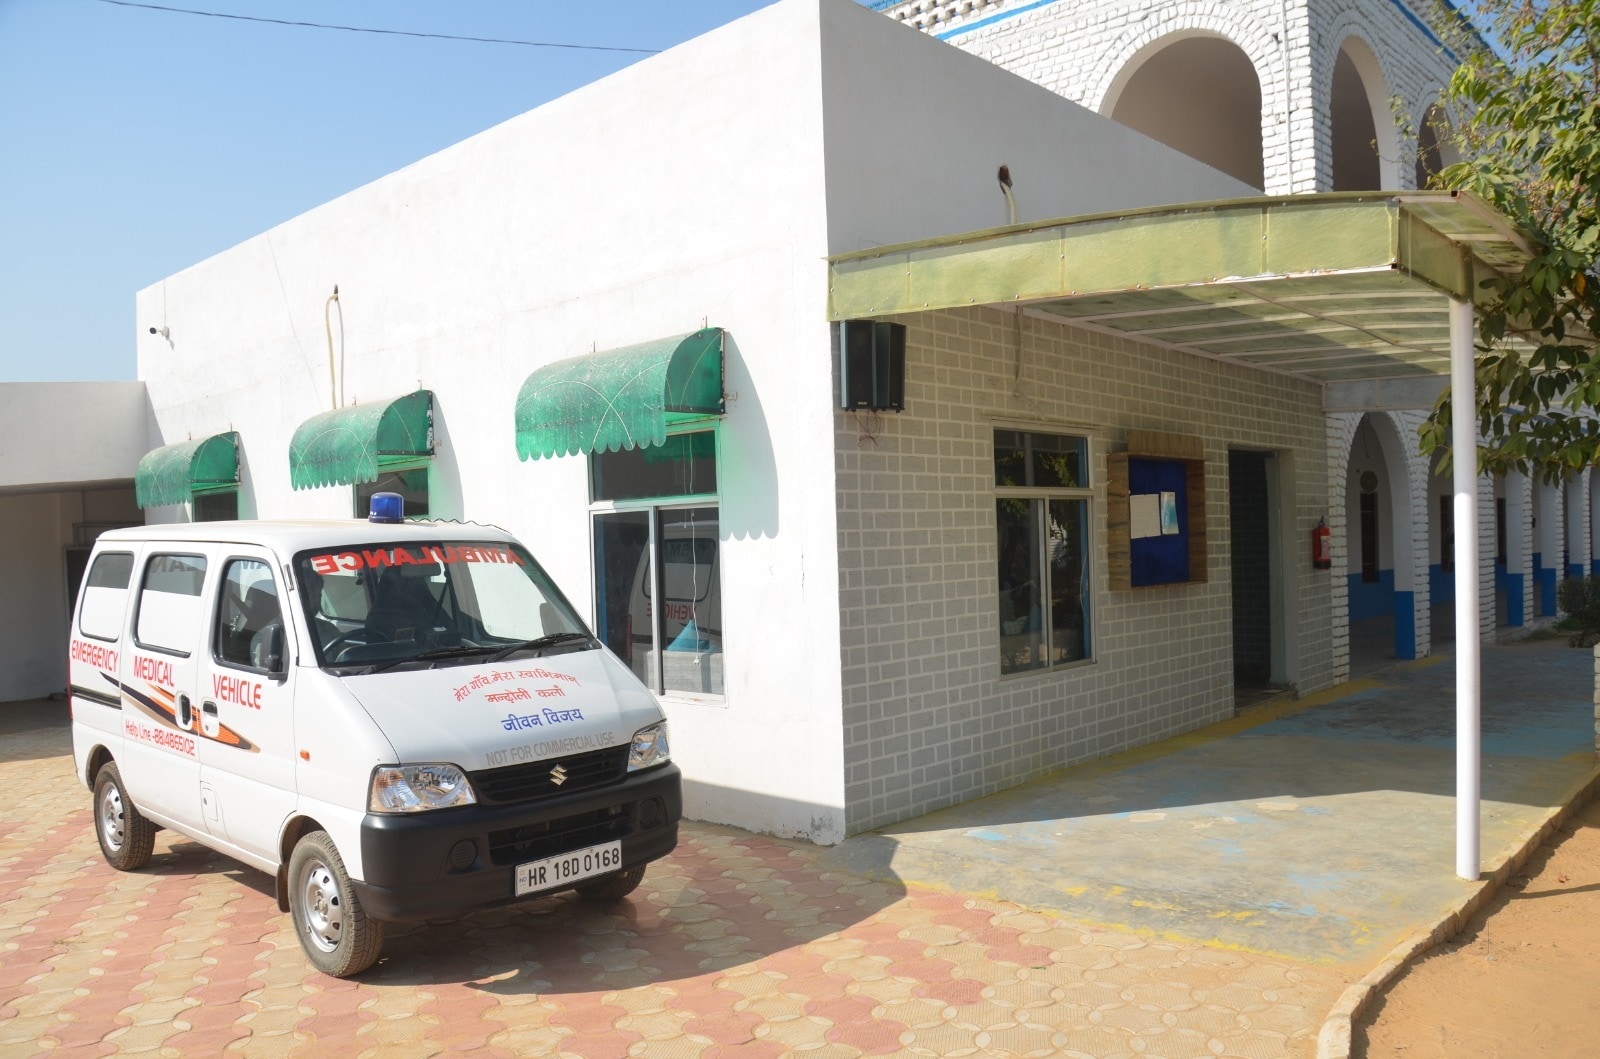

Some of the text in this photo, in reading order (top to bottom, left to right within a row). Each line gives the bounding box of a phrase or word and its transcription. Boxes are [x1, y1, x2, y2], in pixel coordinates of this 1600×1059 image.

[71, 640, 262, 710] EMERGENCY MEDICAL VEHICLE
[453, 685, 471, 702] मेरा
[491, 670, 515, 682] मेरा
[125, 719, 139, 739] Help
[139, 723, 151, 742] Line
[501, 707, 585, 732] जीवन विजय
[485, 731, 616, 767] NOT FOR COMMERCIAL USE
[528, 847, 620, 887] HR 18D 0168
